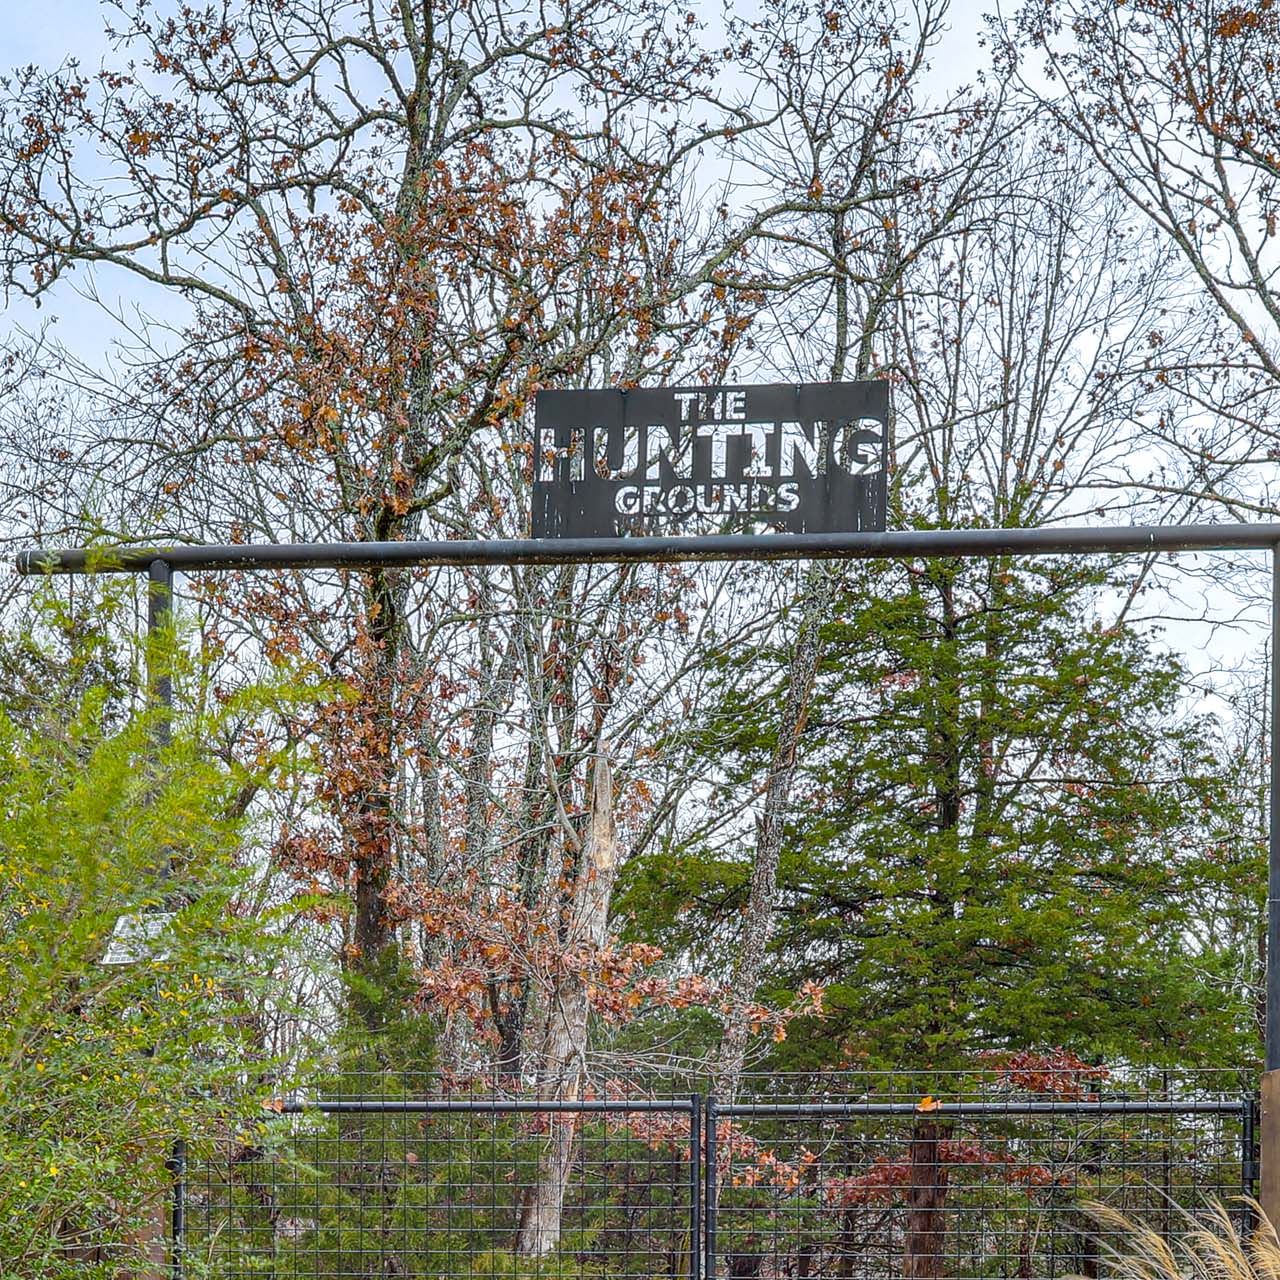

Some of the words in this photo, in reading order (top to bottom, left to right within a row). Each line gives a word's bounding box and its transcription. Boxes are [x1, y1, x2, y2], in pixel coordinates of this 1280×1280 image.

[673, 390, 746, 421] THE
[537, 418, 885, 482] HUNTING
[614, 482, 801, 515] GROUNDS
